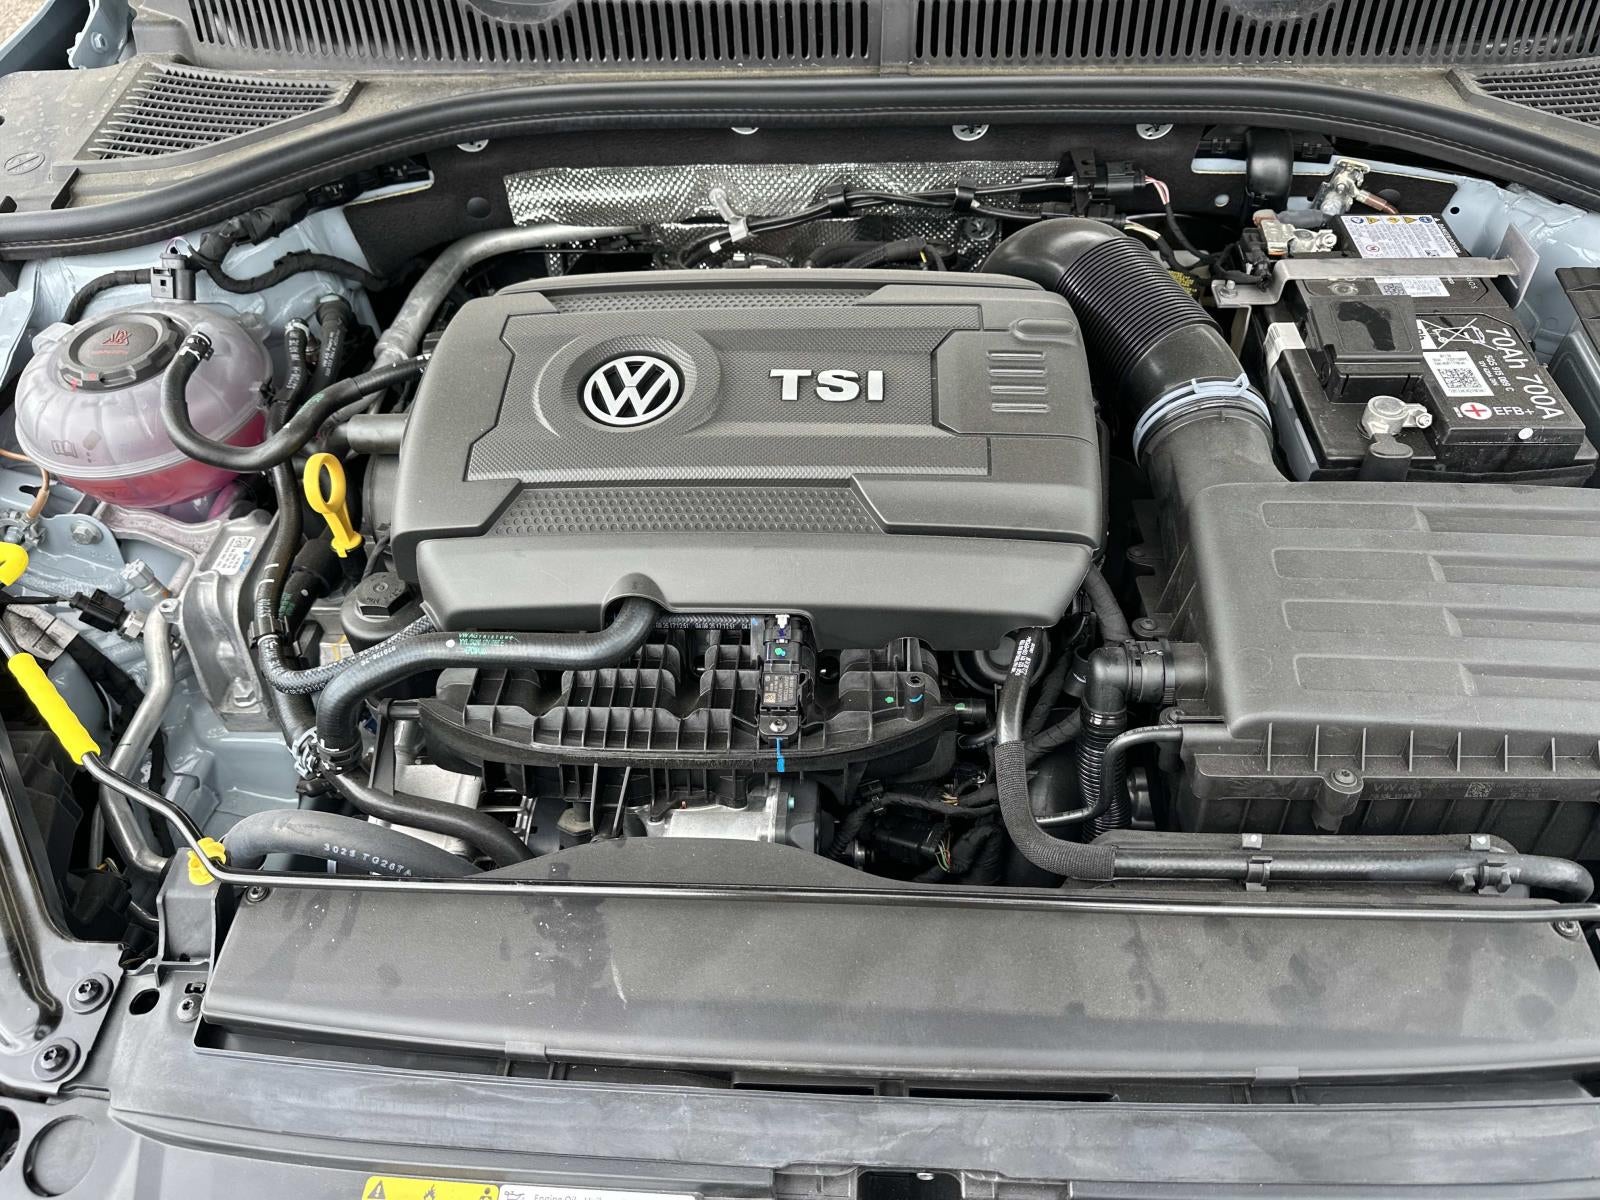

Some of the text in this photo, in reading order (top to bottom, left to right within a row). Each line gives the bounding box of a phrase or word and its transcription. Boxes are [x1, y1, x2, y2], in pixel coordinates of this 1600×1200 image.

[769, 368, 884, 402] TSI
[1485, 327, 1530, 369] 70Ah
[1515, 373, 1566, 420] 700A
[1492, 406, 1535, 416] EFB+
